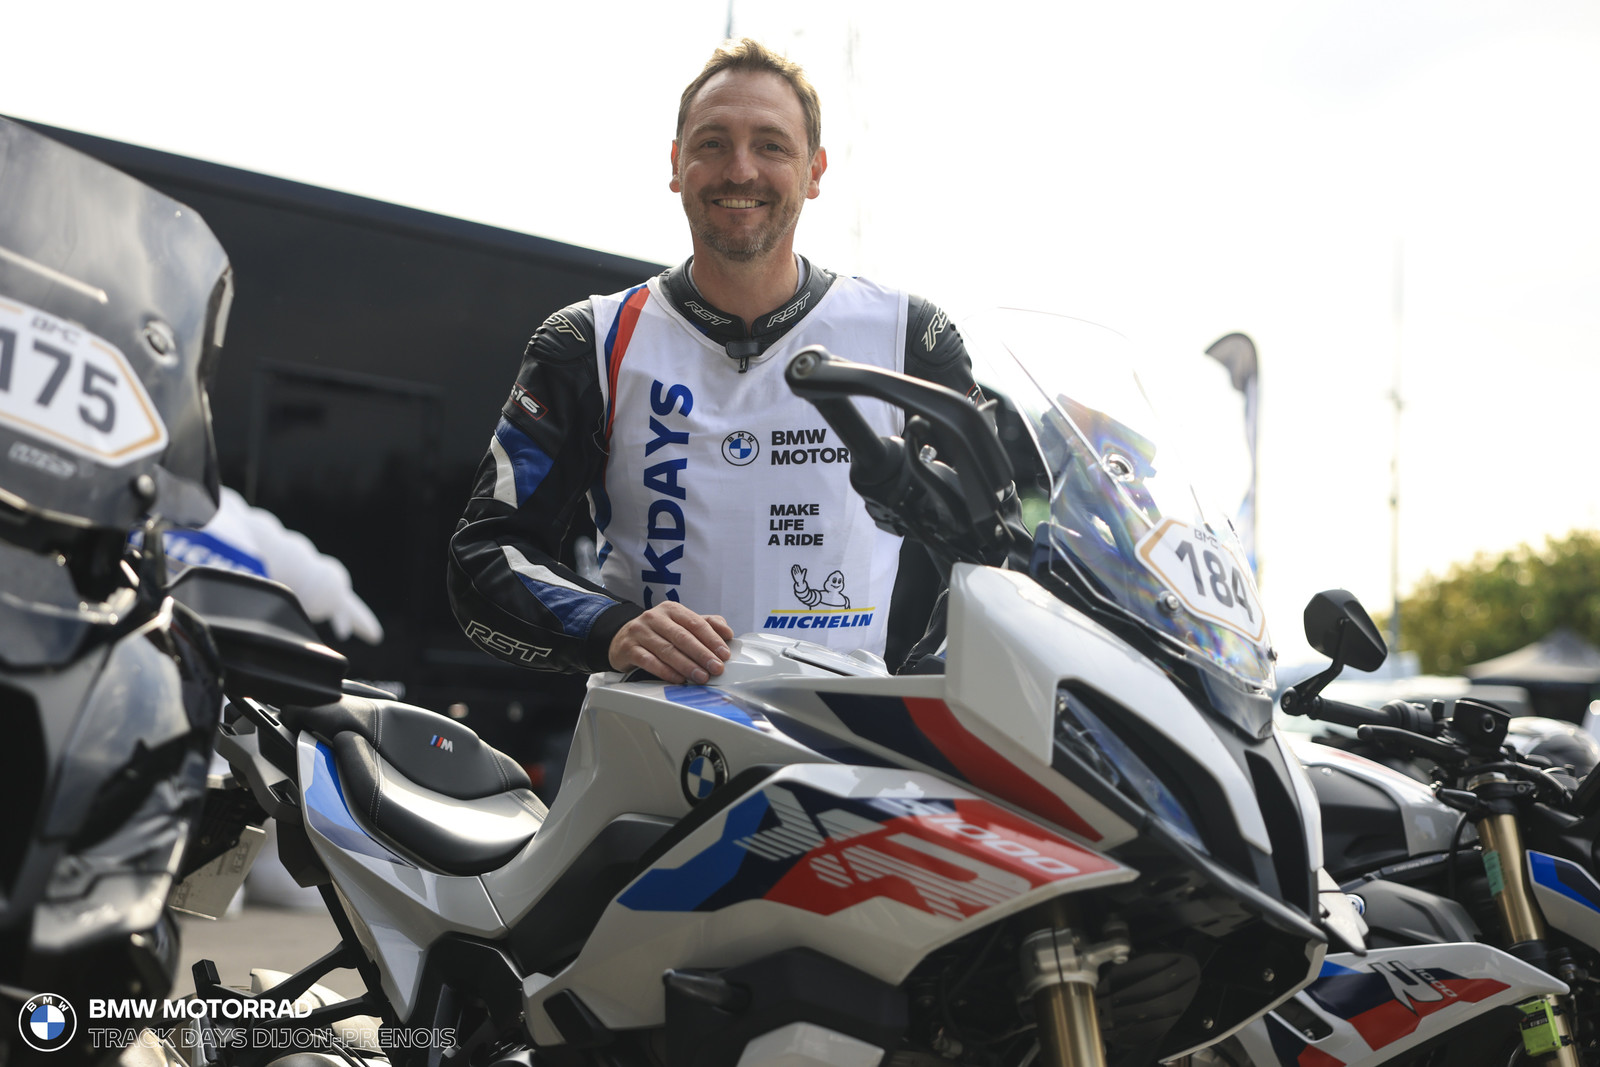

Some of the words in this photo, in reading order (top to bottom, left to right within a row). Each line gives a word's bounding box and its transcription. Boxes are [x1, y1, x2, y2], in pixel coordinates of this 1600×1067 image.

[684, 300, 732, 326] RST
[766, 291, 811, 328] RST
[543, 312, 587, 343] ST
[0, 325, 118, 435] 175
[771, 429, 827, 446] BMW
[770, 448, 852, 466] MOTOR
[770, 504, 820, 516] MAKE
[769, 519, 804, 531] LIFE
[768, 534, 780, 546] A
[784, 533, 824, 546] RIDE
[1175, 540, 1255, 624] 184
[763, 613, 873, 629] MICHELIN
[465, 620, 552, 662] RST
